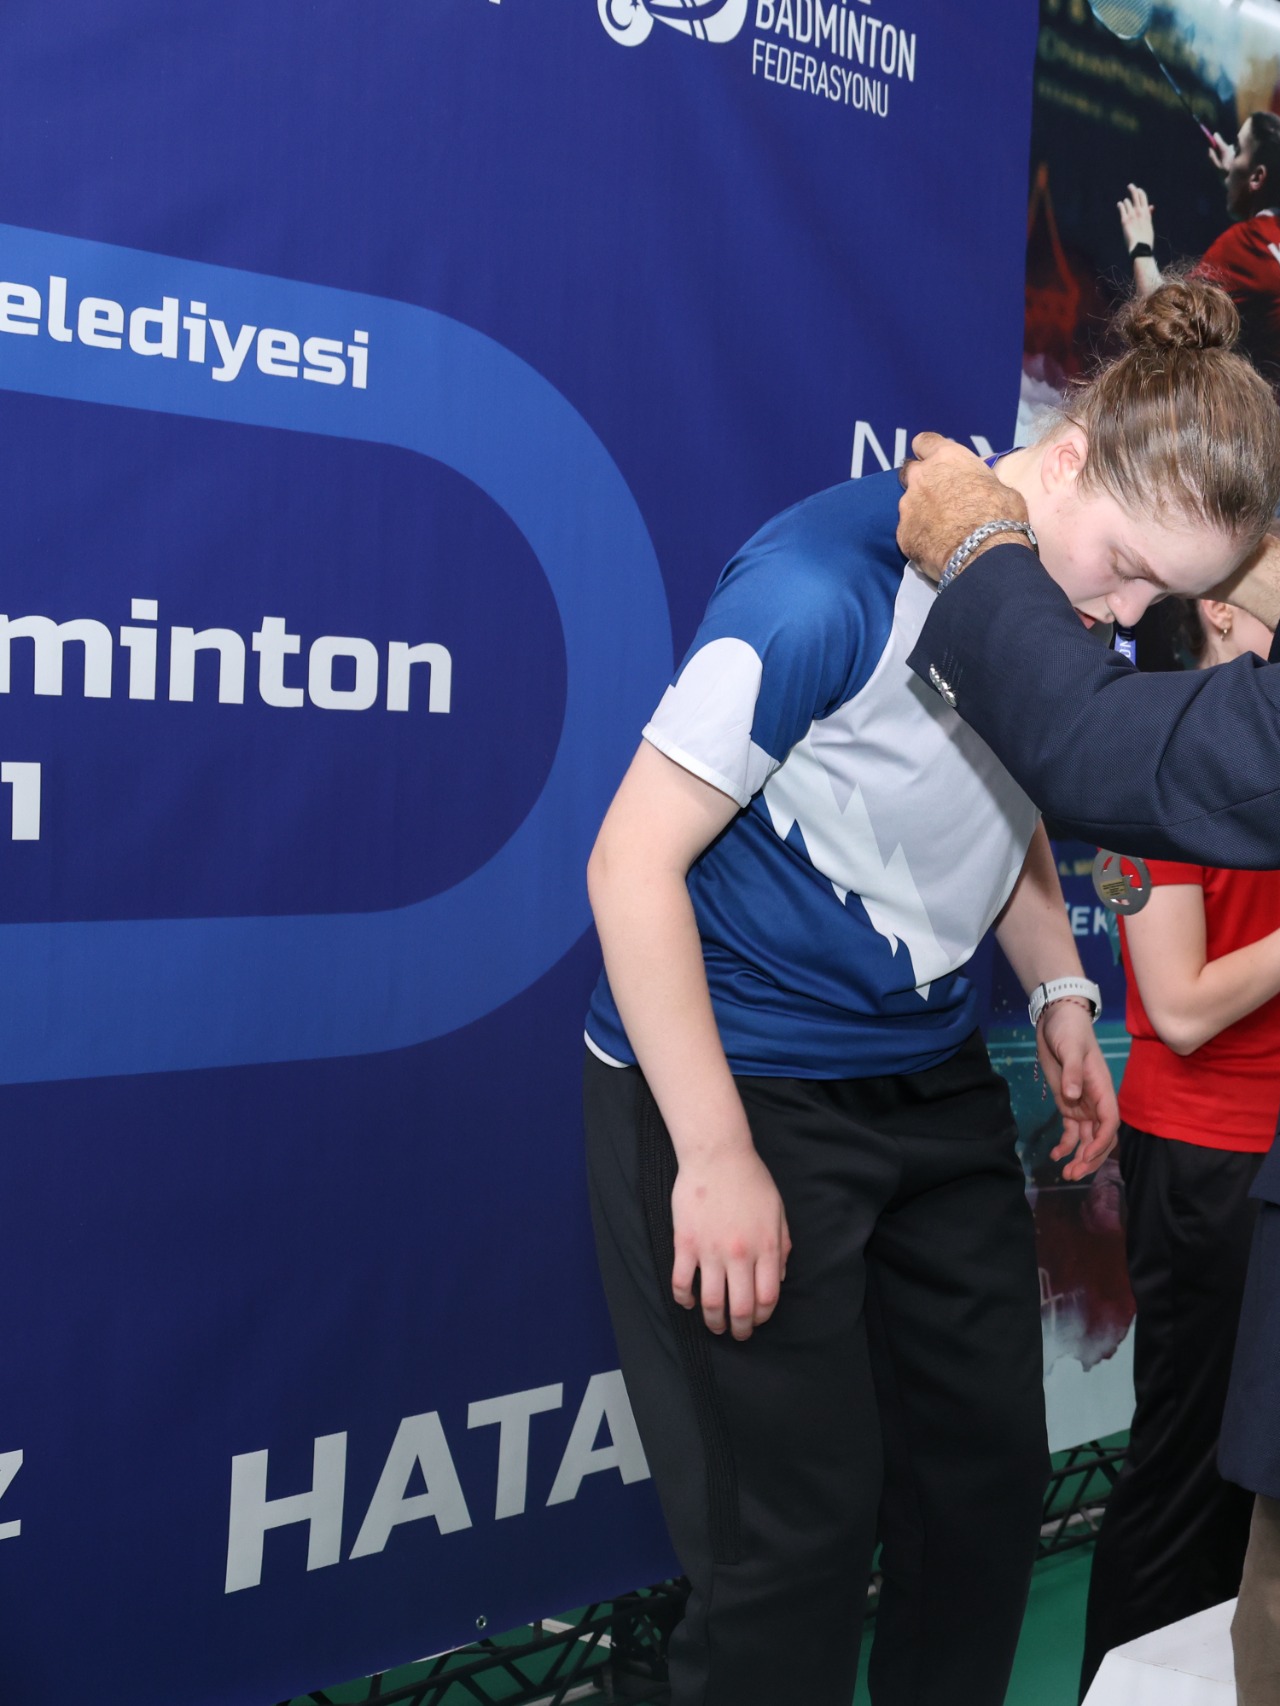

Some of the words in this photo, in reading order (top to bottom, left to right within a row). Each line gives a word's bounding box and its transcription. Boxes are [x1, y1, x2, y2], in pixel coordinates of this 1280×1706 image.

[752, 38, 888, 117] FEDERASYONU
[0, 275, 369, 389] elediyesi
[0, 598, 452, 713] minton
